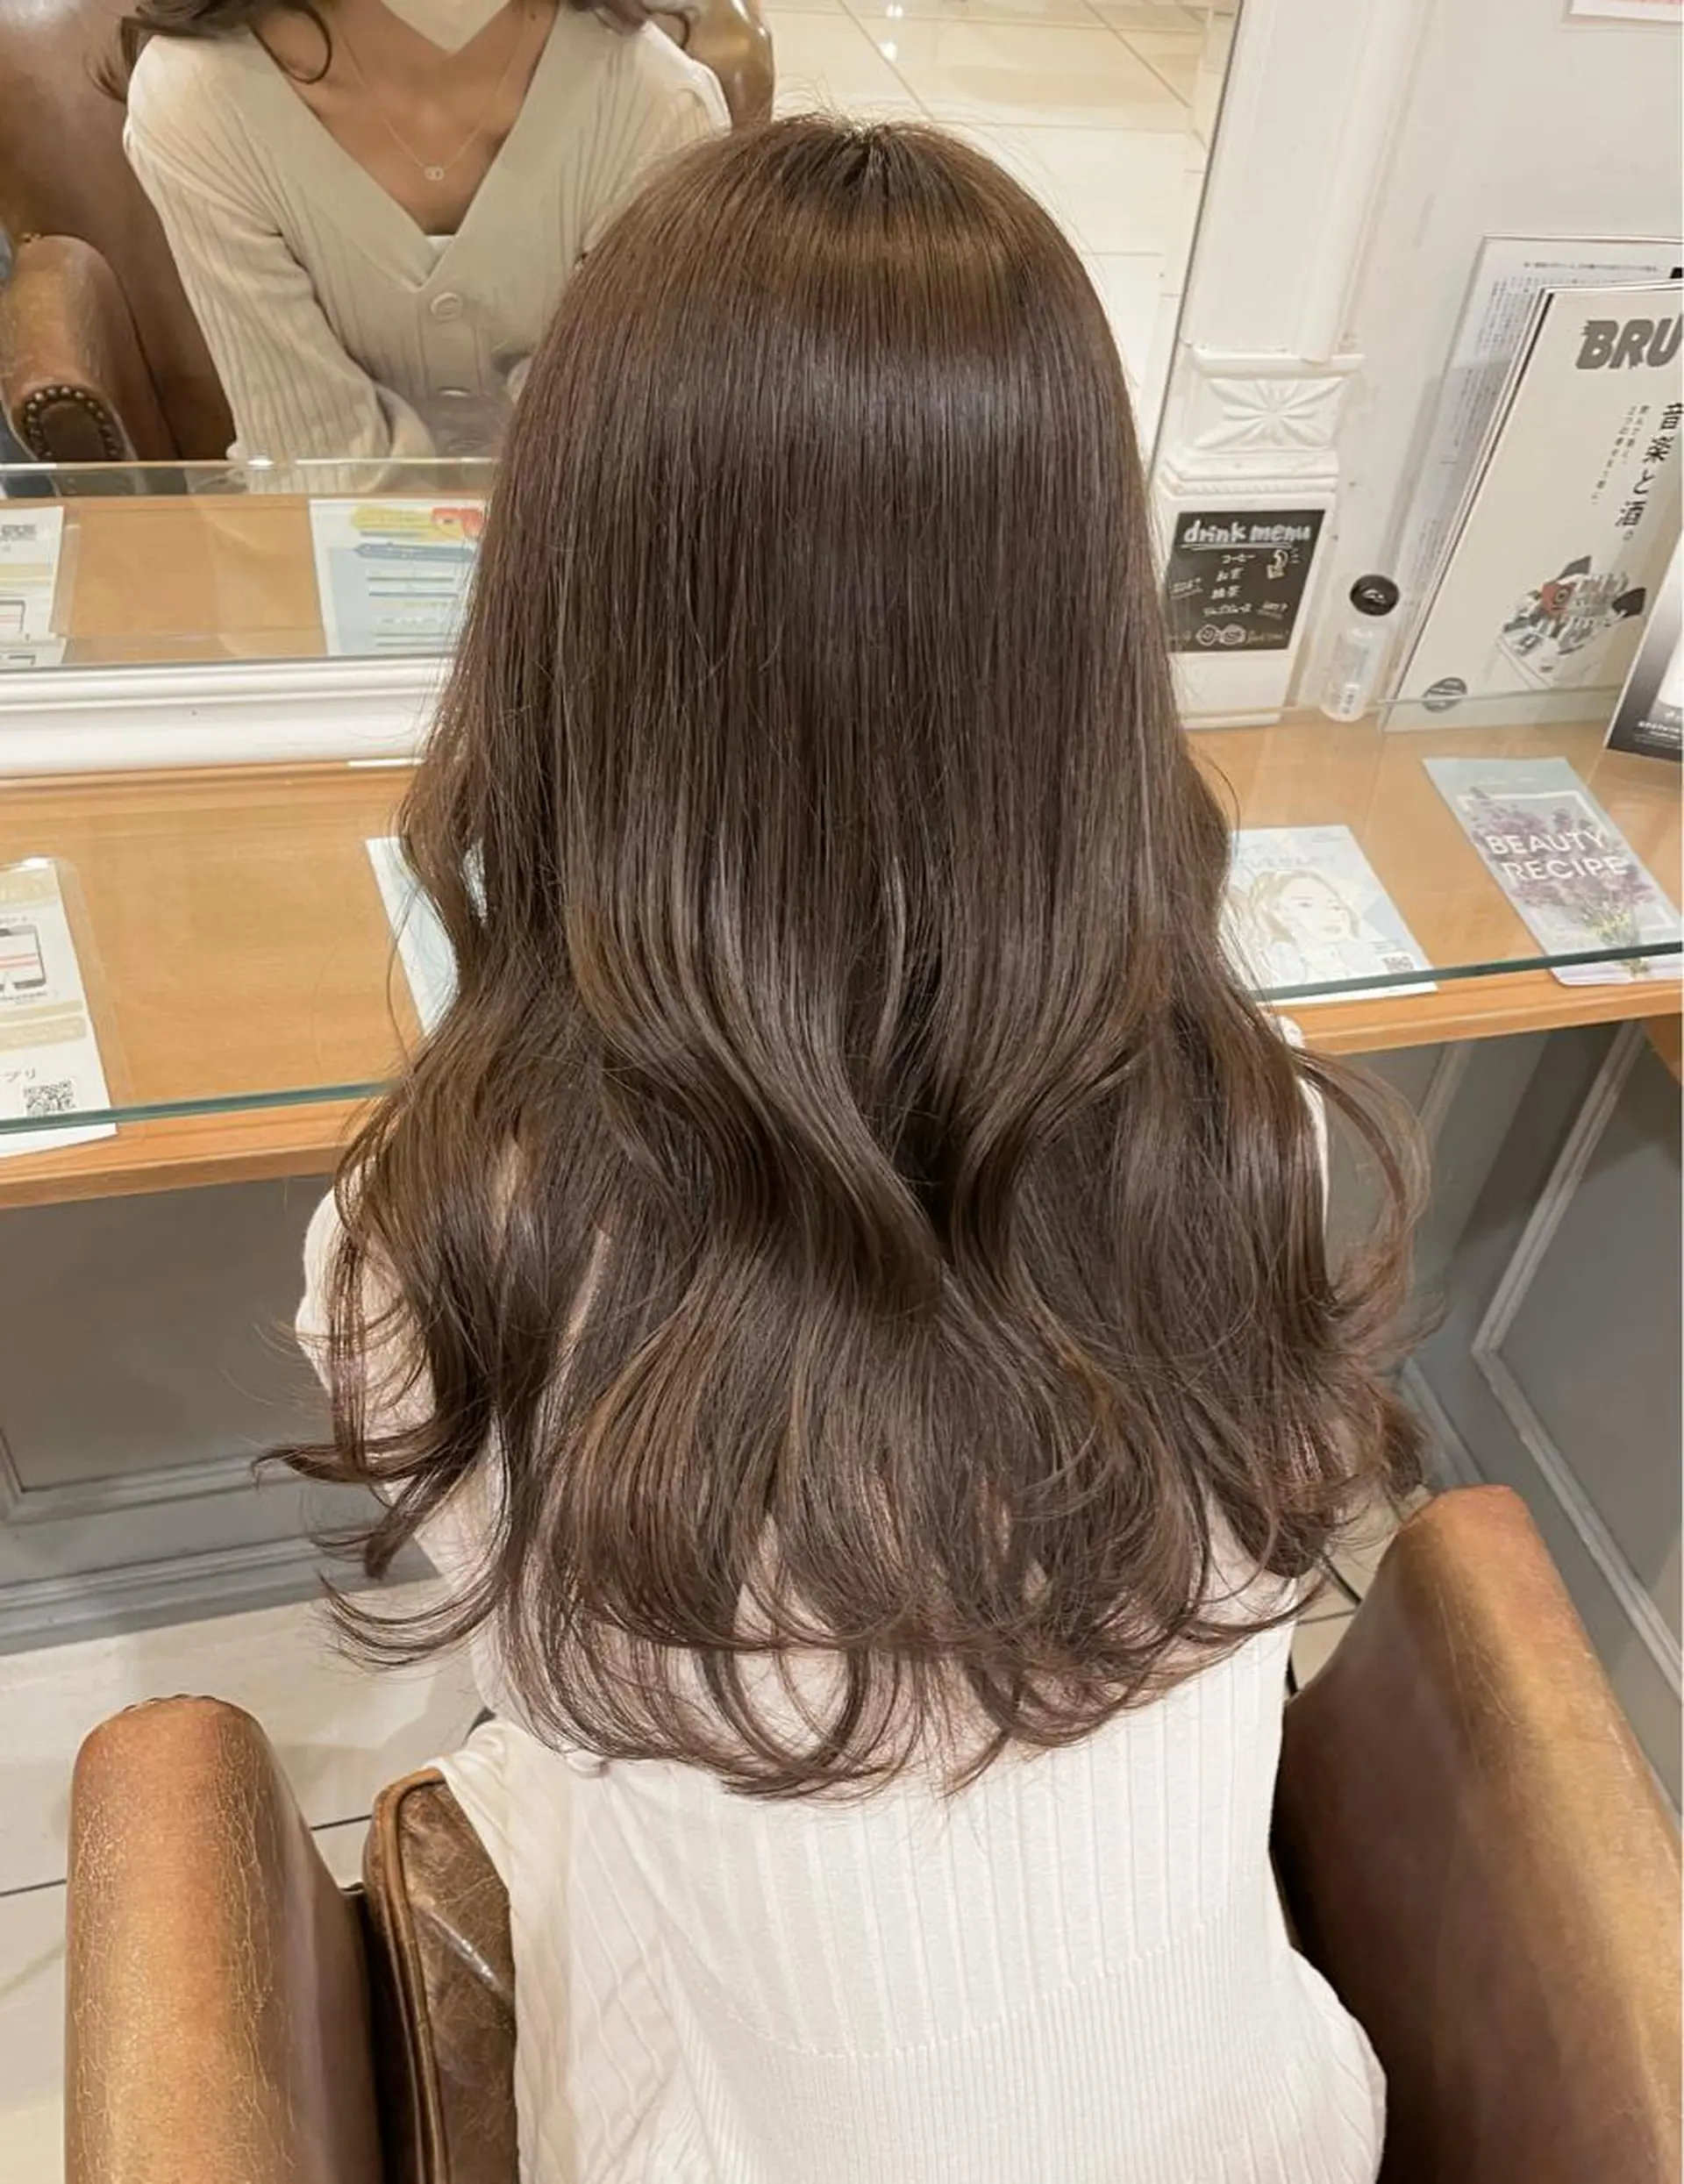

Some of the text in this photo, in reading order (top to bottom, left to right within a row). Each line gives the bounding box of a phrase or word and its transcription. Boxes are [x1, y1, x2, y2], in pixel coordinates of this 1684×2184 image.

[1183, 519, 1311, 543] drink menu
[1485, 830, 1606, 855] BEAUTY
[1501, 855, 1630, 883] RECIPE
